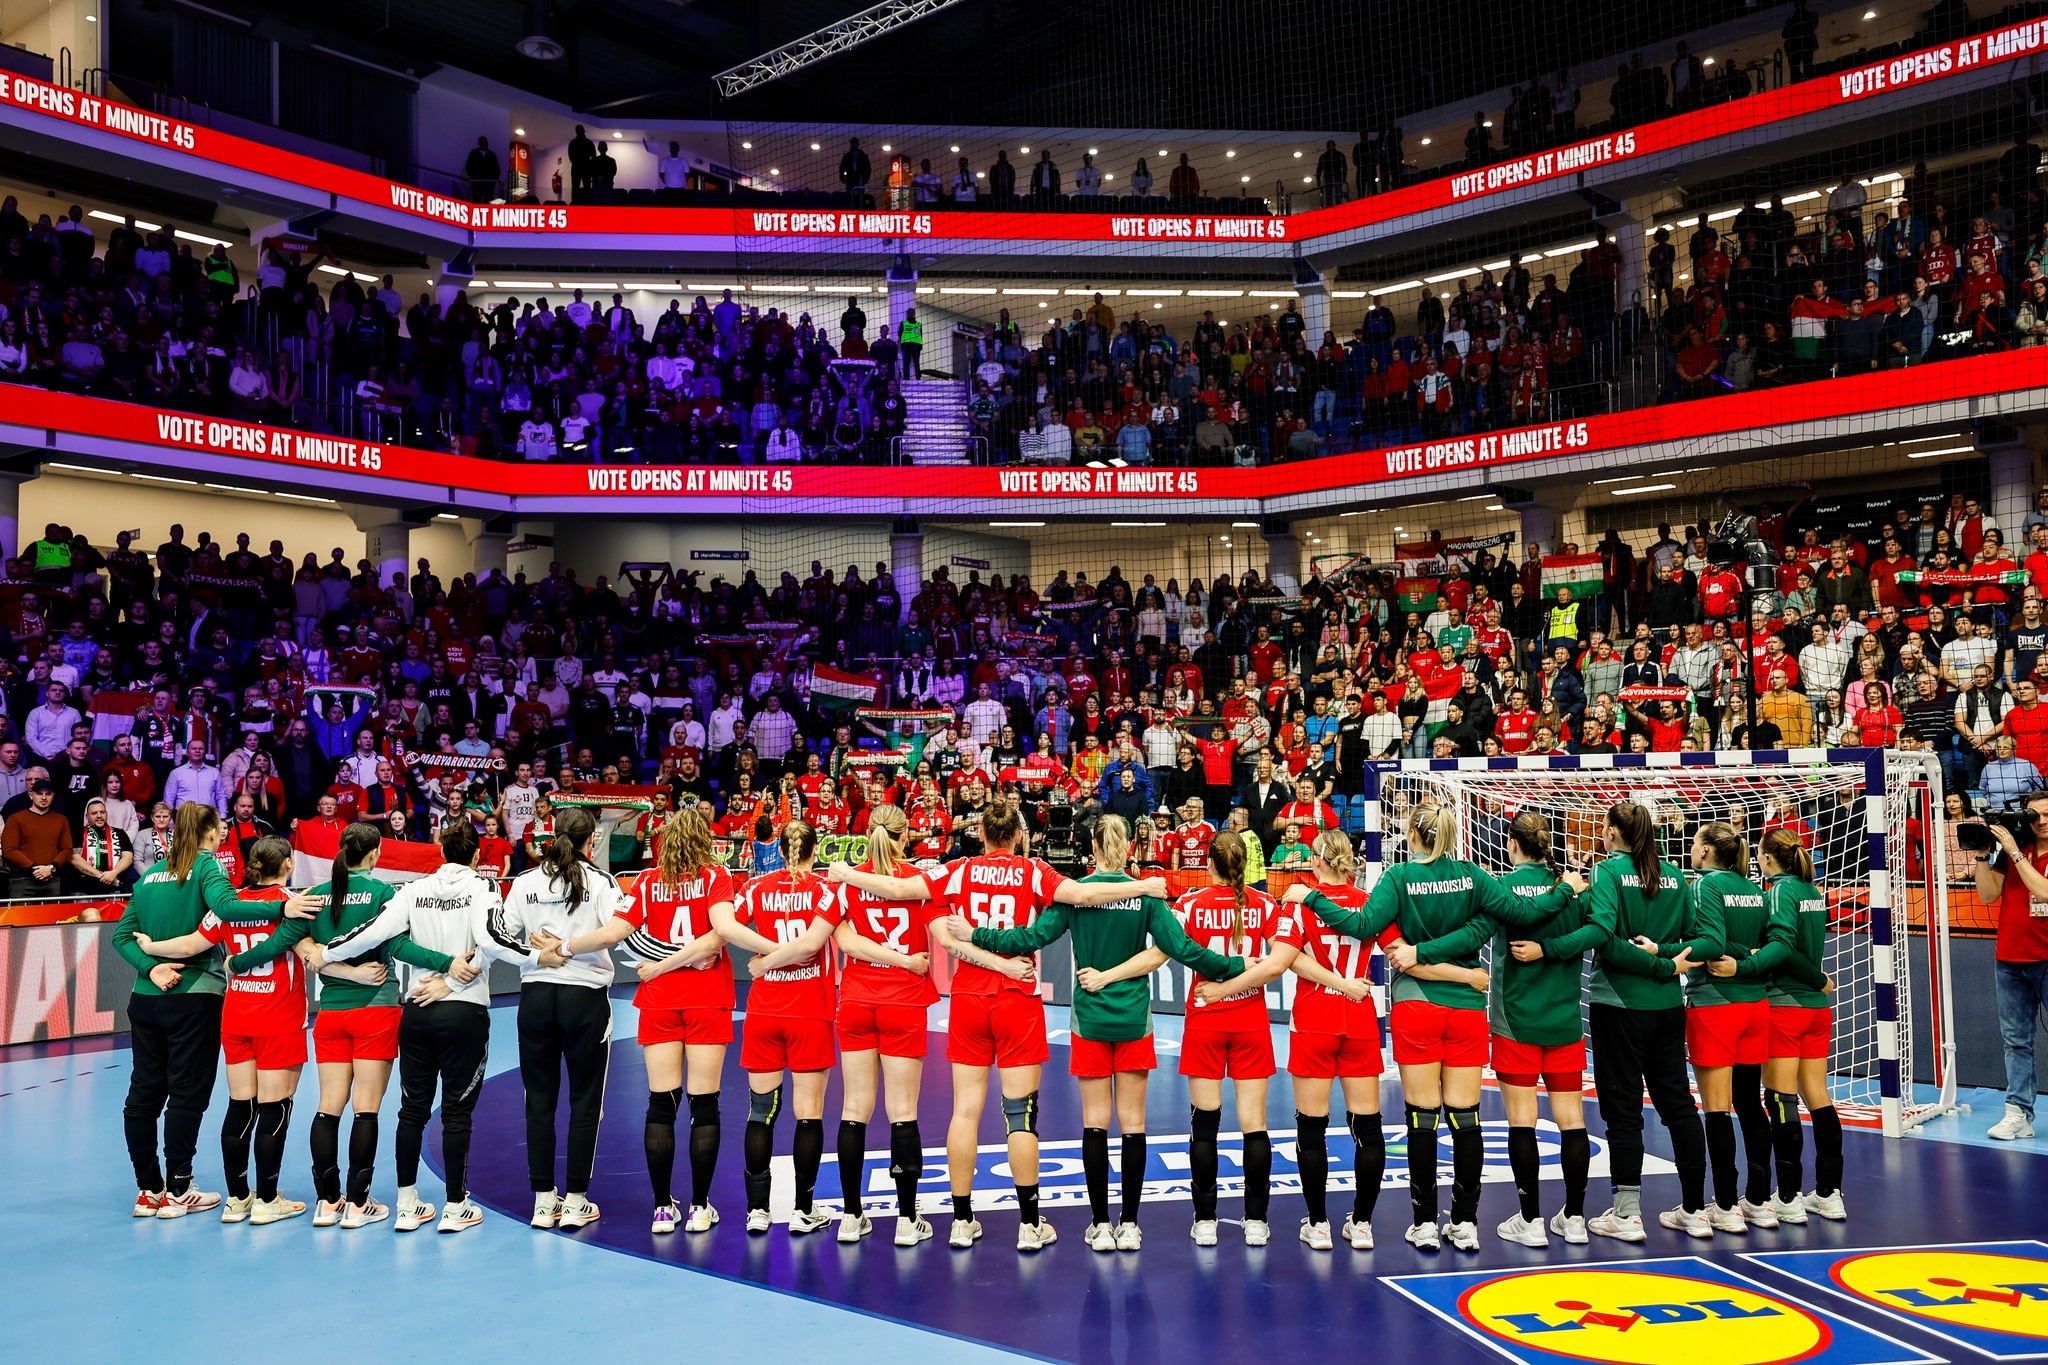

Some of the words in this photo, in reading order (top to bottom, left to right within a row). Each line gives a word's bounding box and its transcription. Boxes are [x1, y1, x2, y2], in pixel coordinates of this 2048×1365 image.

[1840, 65, 1885, 98] VOTE
[1890, 47, 1952, 85] OPENS
[1958, 38, 1981, 67] AT
[14, 78, 74, 116] OPENS
[79, 98, 101, 123] AT
[105, 105, 169, 143] MINUTE
[172, 125, 195, 149] 45
[1451, 171, 1485, 198] VOTE
[1488, 159, 1533, 189] OPENS
[1536, 153, 1554, 177] AT
[1557, 138, 1612, 172] MINUTE
[1615, 132, 1635, 154] 45
[391, 185, 424, 212] VOTE
[426, 196, 468, 224] OPENS
[472, 208, 487, 227] AT
[492, 208, 545, 228] MINUTE
[548, 209, 567, 228] 45
[753, 212, 787, 231] VOTE
[791, 213, 836, 232] OPENS
[839, 214, 856, 233] AT
[859, 214, 911, 234] MINUTE
[913, 215, 932, 234] 45
[1111, 217, 1145, 236] VOTE
[1148, 218, 1192, 237] OPENS
[1195, 219, 1212, 237] AT
[1214, 219, 1264, 238] MINUTE
[1267, 219, 1285, 238] 45
[157, 413, 204, 445] VOTE
[208, 422, 266, 454] OPENS
[270, 432, 292, 457] AT
[296, 435, 357, 467] MINUTE
[360, 446, 382, 471] 45
[1386, 447, 1423, 474] VOTE
[1425, 440, 1475, 471] OPENS
[1479, 436, 1497, 461] AT
[1501, 426, 1562, 458] MINUTE
[1566, 422, 1588, 447] 45
[588, 469, 627, 491] VOTE
[630, 469, 682, 491] OPENS
[686, 470, 706, 491] AT
[710, 470, 768, 491] MINUTE
[772, 470, 792, 491] 45
[1000, 470, 1038, 492] VOTE
[1041, 470, 1091, 492] OPENS
[1095, 471, 1113, 492] AT
[1117, 471, 1174, 492] MINUTE
[1177, 471, 1197, 492] 45
[1447, 536, 1501, 550] MAGYARORSZÁG
[429, 689, 450, 697] NIKE
[1619, 687, 1687, 697] AGYARORSZÁG
[421, 753, 492, 768] MAGYARORSZÁG
[1017, 768, 1050, 779] HUNGARY
[523, 793, 530, 802] 13
[143, 869, 193, 885] MAGYARORSG
[970, 865, 1023, 887] BORDÁS
[1621, 874, 1678, 889] MAGSZÁG
[416, 895, 473, 911] MAGYARORSG
[762, 890, 813, 912] MÁRTON
[970, 892, 1016, 930] 58
[669, 906, 695, 945] 4
[866, 907, 910, 954] 52
[1320, 934, 1361, 982] 77
[0, 926, 115, 1046] AL
[231, 979, 276, 993] GYARORSZÁ
